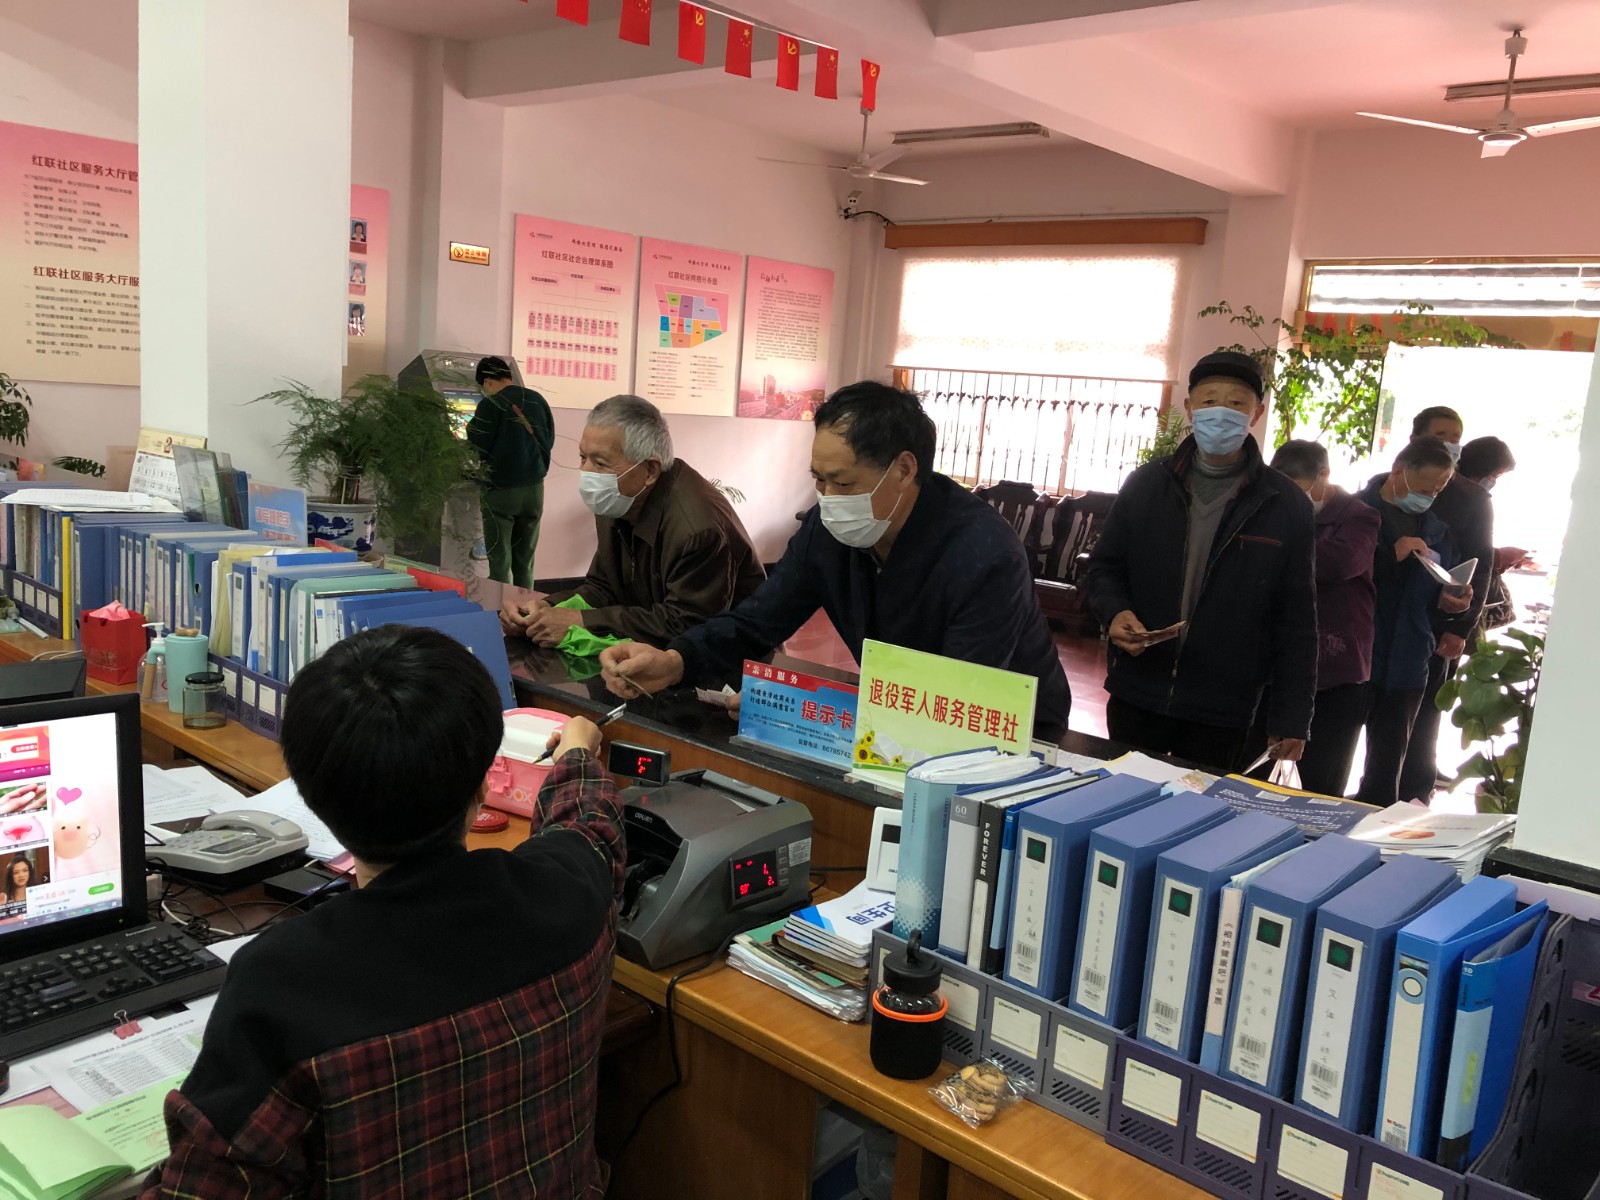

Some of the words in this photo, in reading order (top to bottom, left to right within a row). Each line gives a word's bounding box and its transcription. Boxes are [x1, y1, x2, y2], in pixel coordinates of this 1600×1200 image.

[32, 155, 139, 182] 红联社区服务大厅管
[541, 250, 614, 268] 红联社区社会治理体系图
[33, 265, 140, 287] 红联社区服务大厅服
[164, 436, 173, 453] 2
[801, 699, 855, 730] 提示卡
[868, 677, 1019, 743] 退役军人服务管理社
[822, 744, 852, 759] 86785742
[955, 804, 967, 815] 60
[980, 822, 990, 876] FOREVER
